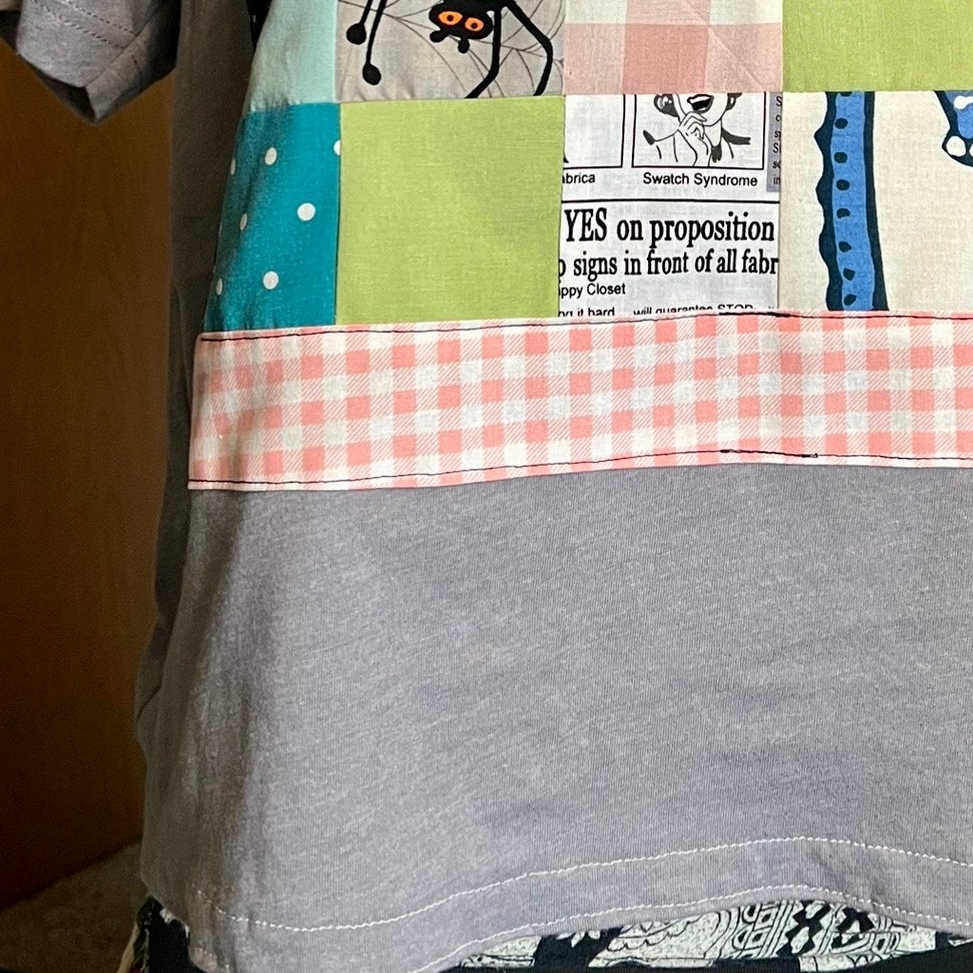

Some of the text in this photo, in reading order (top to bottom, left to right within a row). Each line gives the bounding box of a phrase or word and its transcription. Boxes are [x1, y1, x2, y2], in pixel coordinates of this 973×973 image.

[643, 171, 690, 185] Swatch
[694, 173, 758, 188] Syndrome
[564, 207, 775, 248] YES on proposition
[573, 249, 618, 282] signs
[624, 249, 642, 275] in
[646, 249, 689, 275] front
[694, 247, 715, 273] of
[716, 248, 738, 273] all
[741, 248, 779, 275] fabr
[586, 283, 626, 295] Closet
